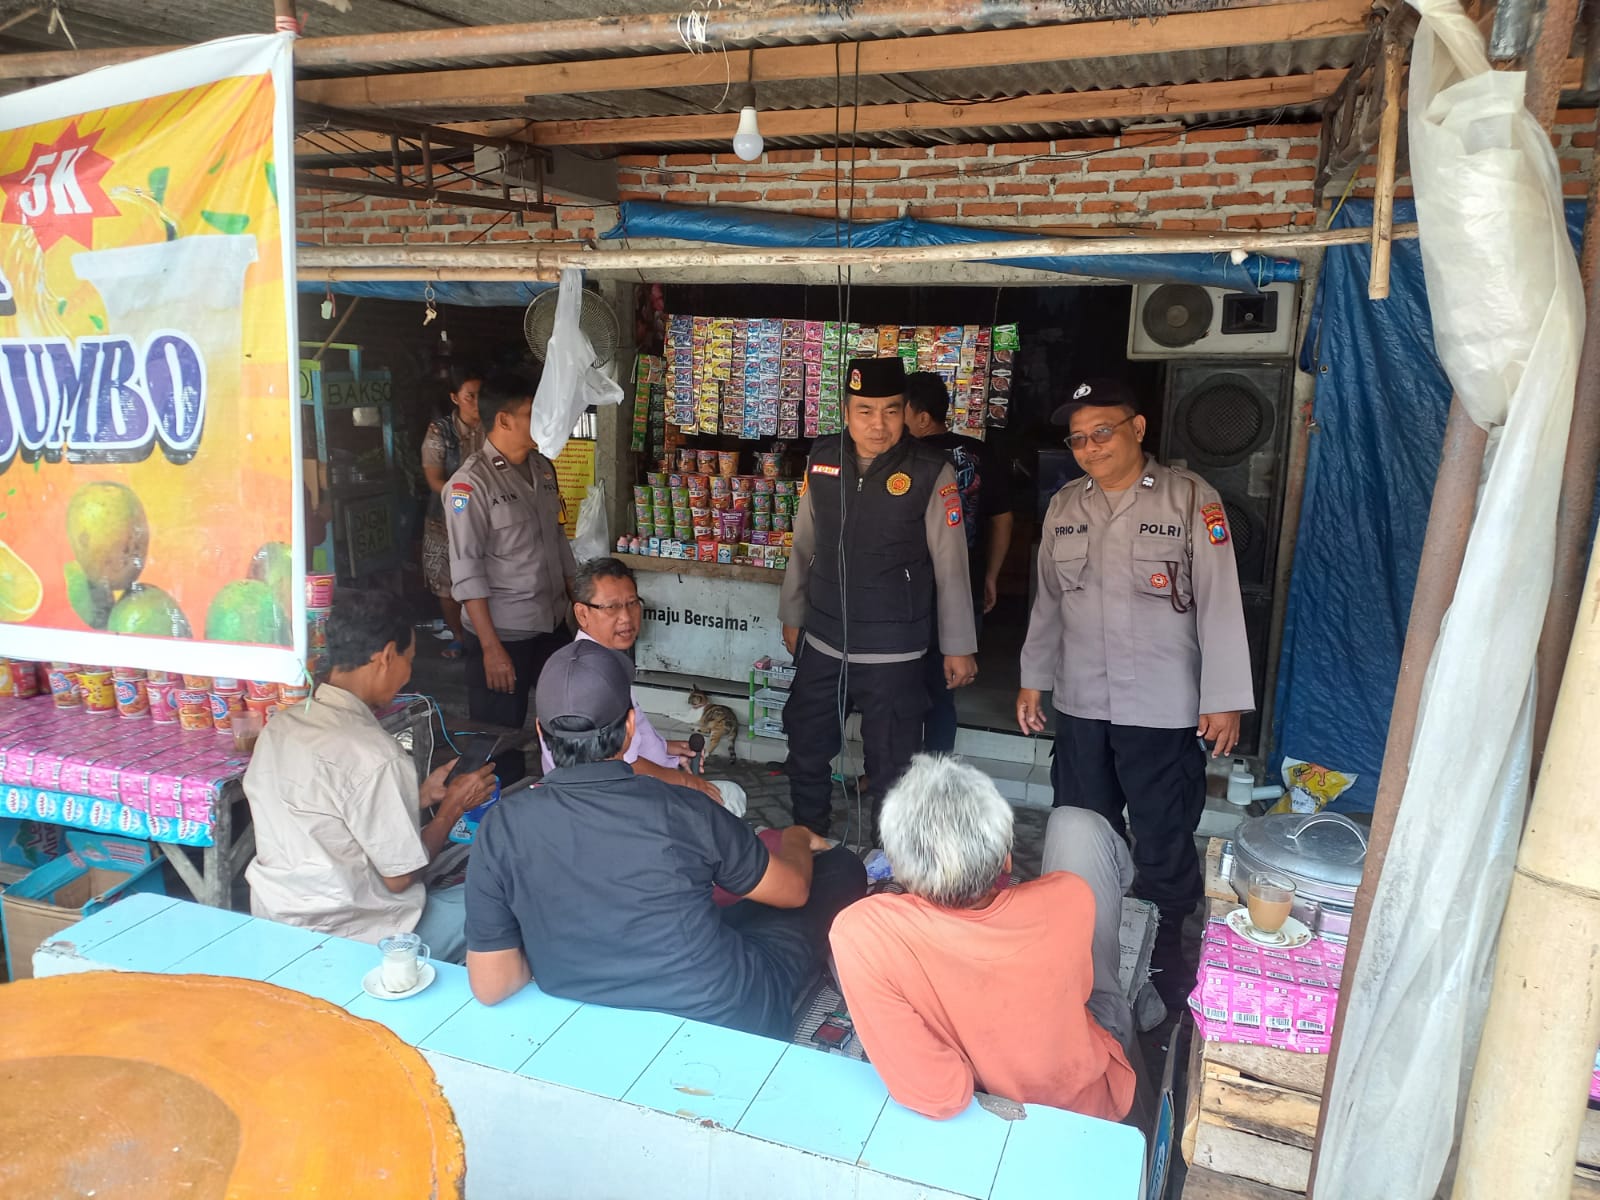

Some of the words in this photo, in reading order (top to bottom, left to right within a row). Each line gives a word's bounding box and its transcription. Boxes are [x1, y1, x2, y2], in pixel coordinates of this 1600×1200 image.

[19, 145, 93, 217] 5K
[1055, 525, 1074, 537] PRIO
[1139, 523, 1181, 537] POLRI
[643, 606, 679, 626] maju
